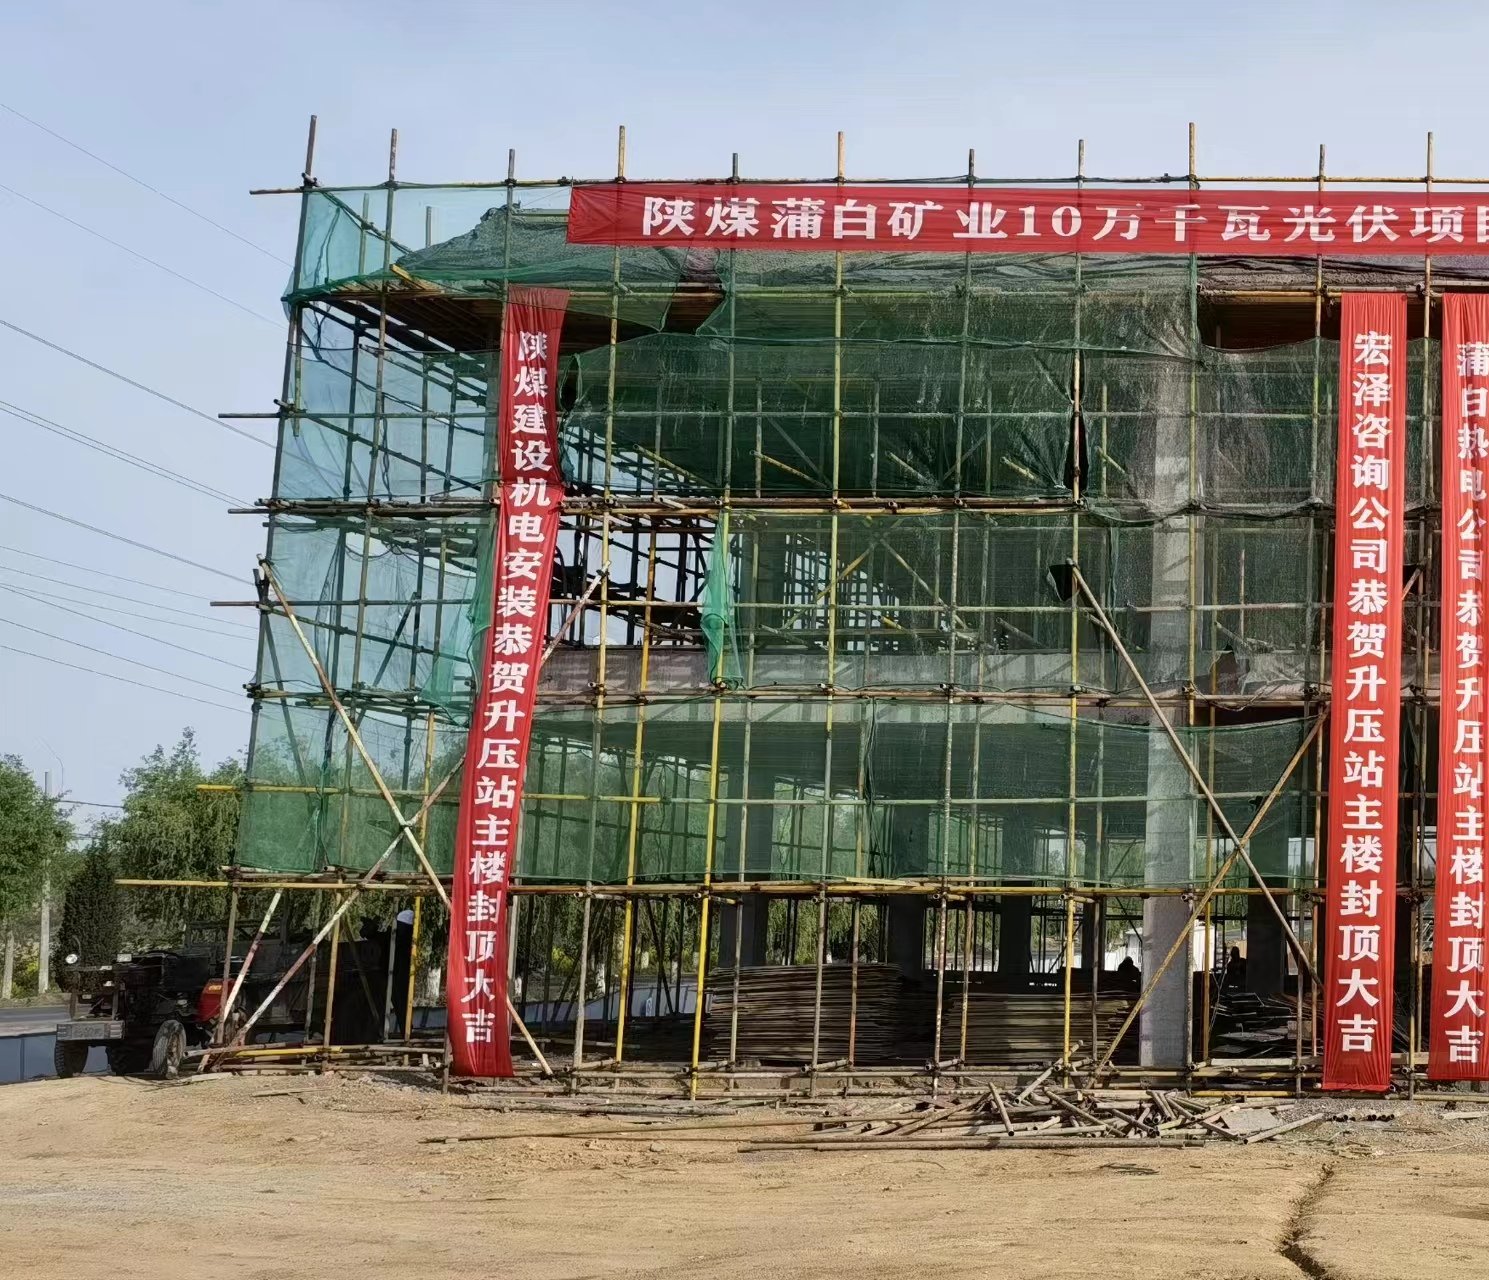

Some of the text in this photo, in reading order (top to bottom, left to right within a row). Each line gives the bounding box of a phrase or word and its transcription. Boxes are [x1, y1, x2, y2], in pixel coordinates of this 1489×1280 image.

[461, 331, 552, 1043] 陕煤建设机电安装恭贺升压站主楼封顶大吉
[1336, 331, 1393, 1053] 宏泽咨询公司恭贺升压站主楼封顶大吉
